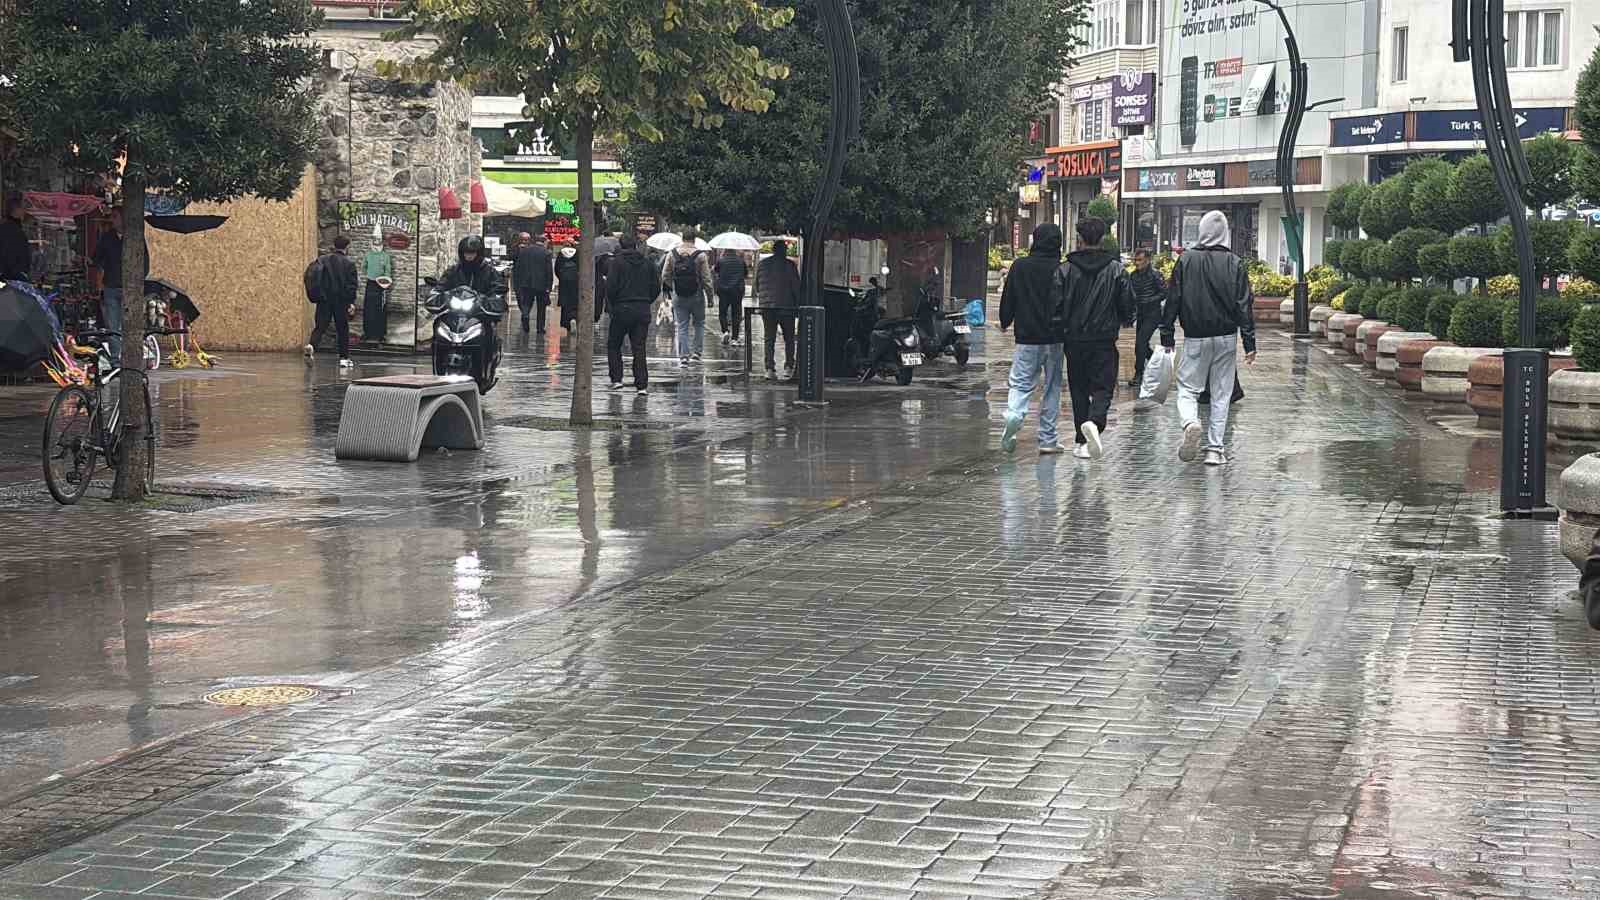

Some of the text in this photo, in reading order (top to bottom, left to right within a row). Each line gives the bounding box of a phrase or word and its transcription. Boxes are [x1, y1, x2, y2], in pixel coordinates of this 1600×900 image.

[1181, 16, 1206, 37] döviz
[1229, 6, 1257, 30] satın!
[1114, 94, 1148, 108] SONSES
[1450, 120, 1471, 130] Türk
[343, 213, 412, 234] BOLU HATIRASI
